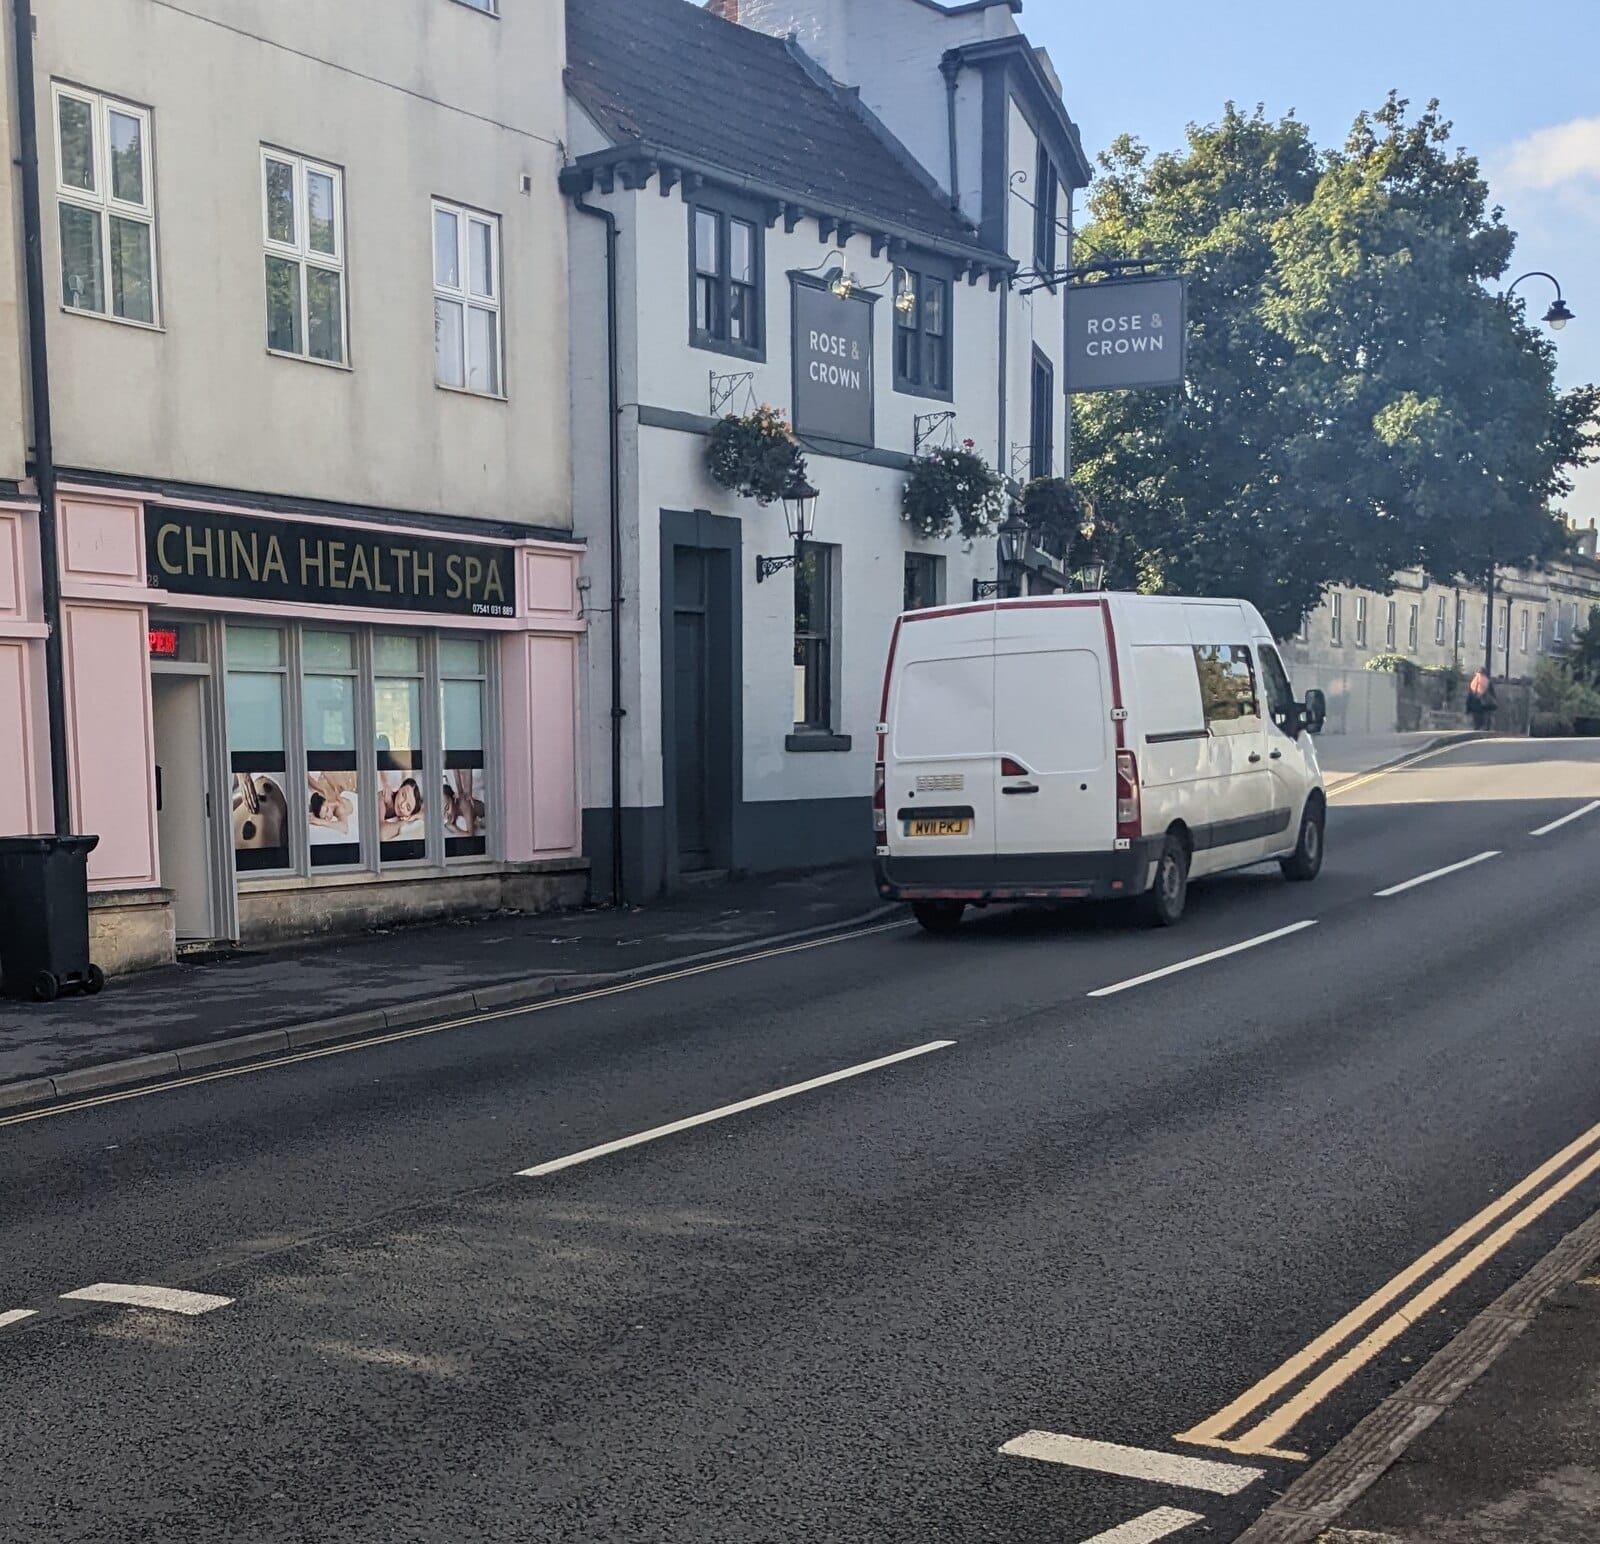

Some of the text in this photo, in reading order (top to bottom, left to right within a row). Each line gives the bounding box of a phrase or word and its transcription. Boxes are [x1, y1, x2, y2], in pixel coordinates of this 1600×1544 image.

[1087, 313, 1163, 334] ROSE &
[810, 330, 859, 360] ROSE &
[1086, 335, 1163, 356] CROWN
[809, 361, 860, 390] CROWN
[156, 523, 505, 602] CHINA HEALTH SPA
[148, 631, 176, 653] PEN
